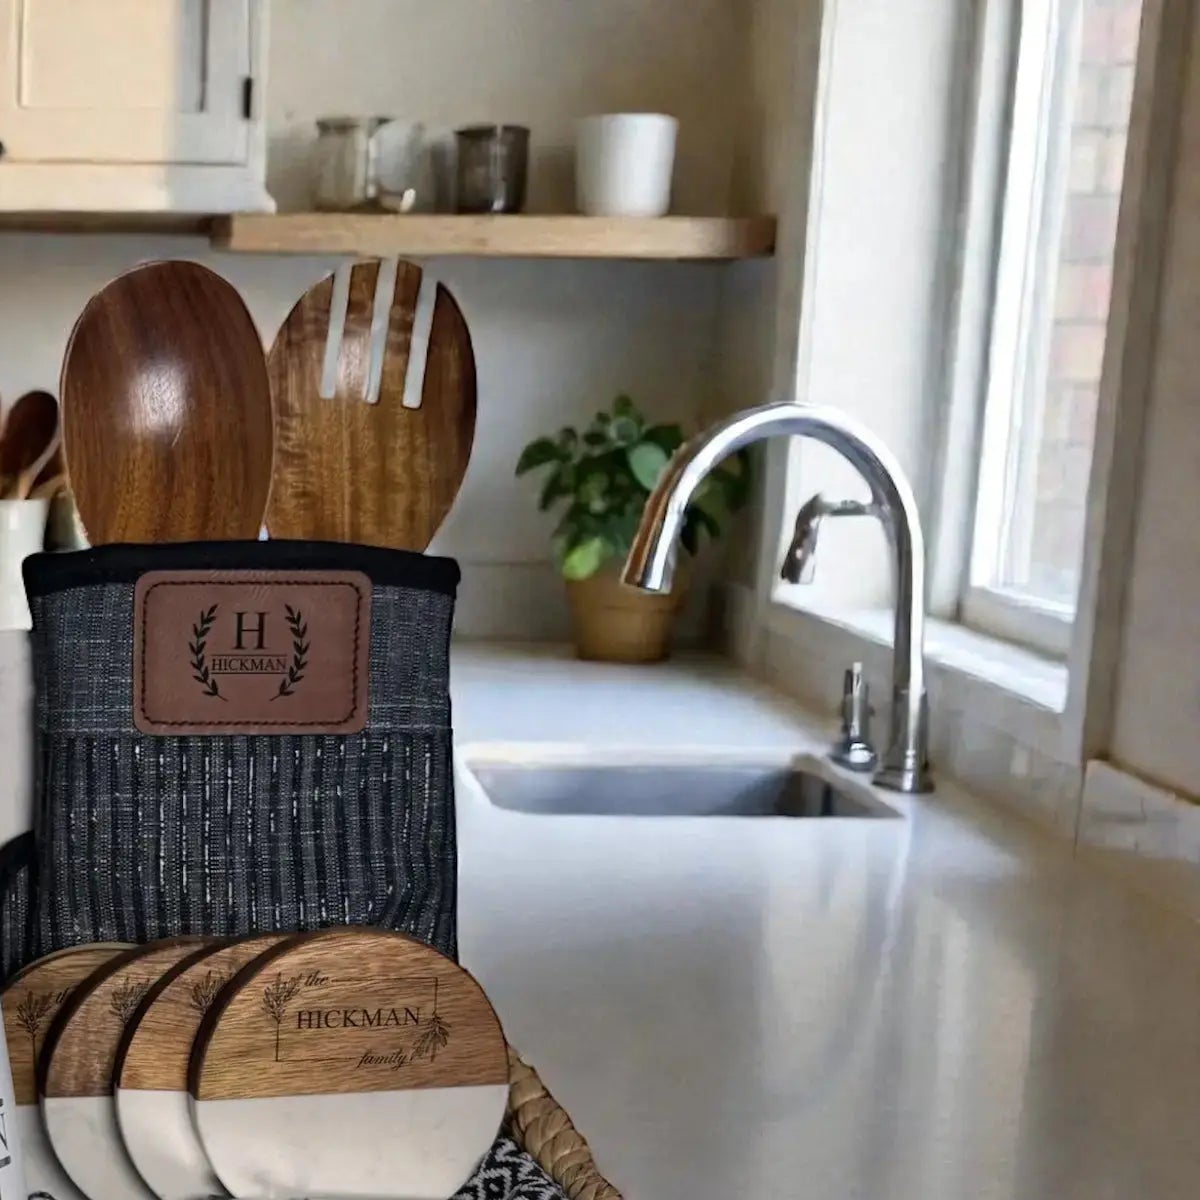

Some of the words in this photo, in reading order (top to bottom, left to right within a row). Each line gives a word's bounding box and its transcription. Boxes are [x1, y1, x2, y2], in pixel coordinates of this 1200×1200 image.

[233, 611, 271, 650] H
[210, 656, 287, 671] HICKMAN
[304, 970, 330, 987] the
[297, 1007, 420, 1029] HICKMAN
[357, 1049, 409, 1071] family
